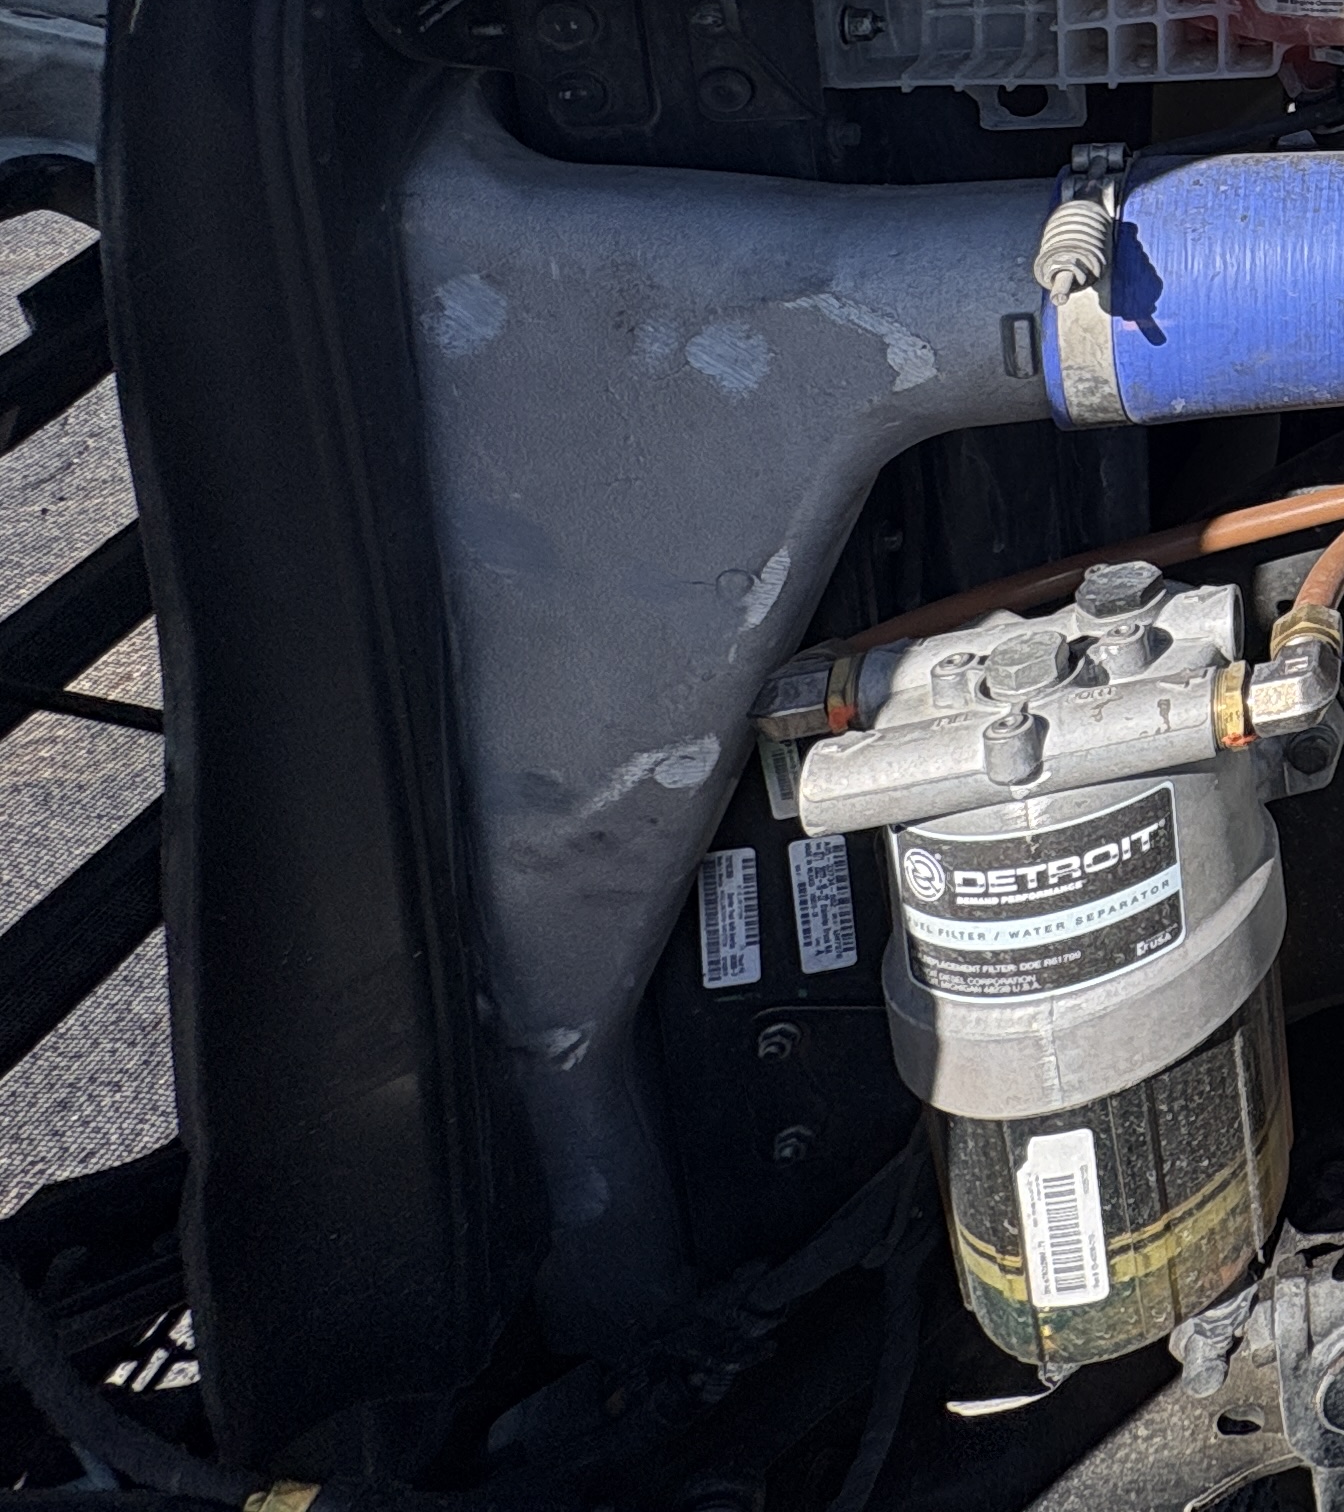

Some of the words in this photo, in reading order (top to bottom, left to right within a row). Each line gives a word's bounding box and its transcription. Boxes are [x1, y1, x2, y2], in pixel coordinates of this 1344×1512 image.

[953, 823, 1159, 894] DETROIT
[956, 896, 999, 905] DEMAND
[1001, 879, 1084, 905] PERFORMANCE
[938, 928, 986, 941] FILTER
[993, 931, 1000, 941] /
[1008, 921, 1066, 939] WATER
[1075, 879, 1170, 926] SEPARATOR
[1150, 933, 1172, 949] USA
[967, 974, 1037, 986] CORPORATION
